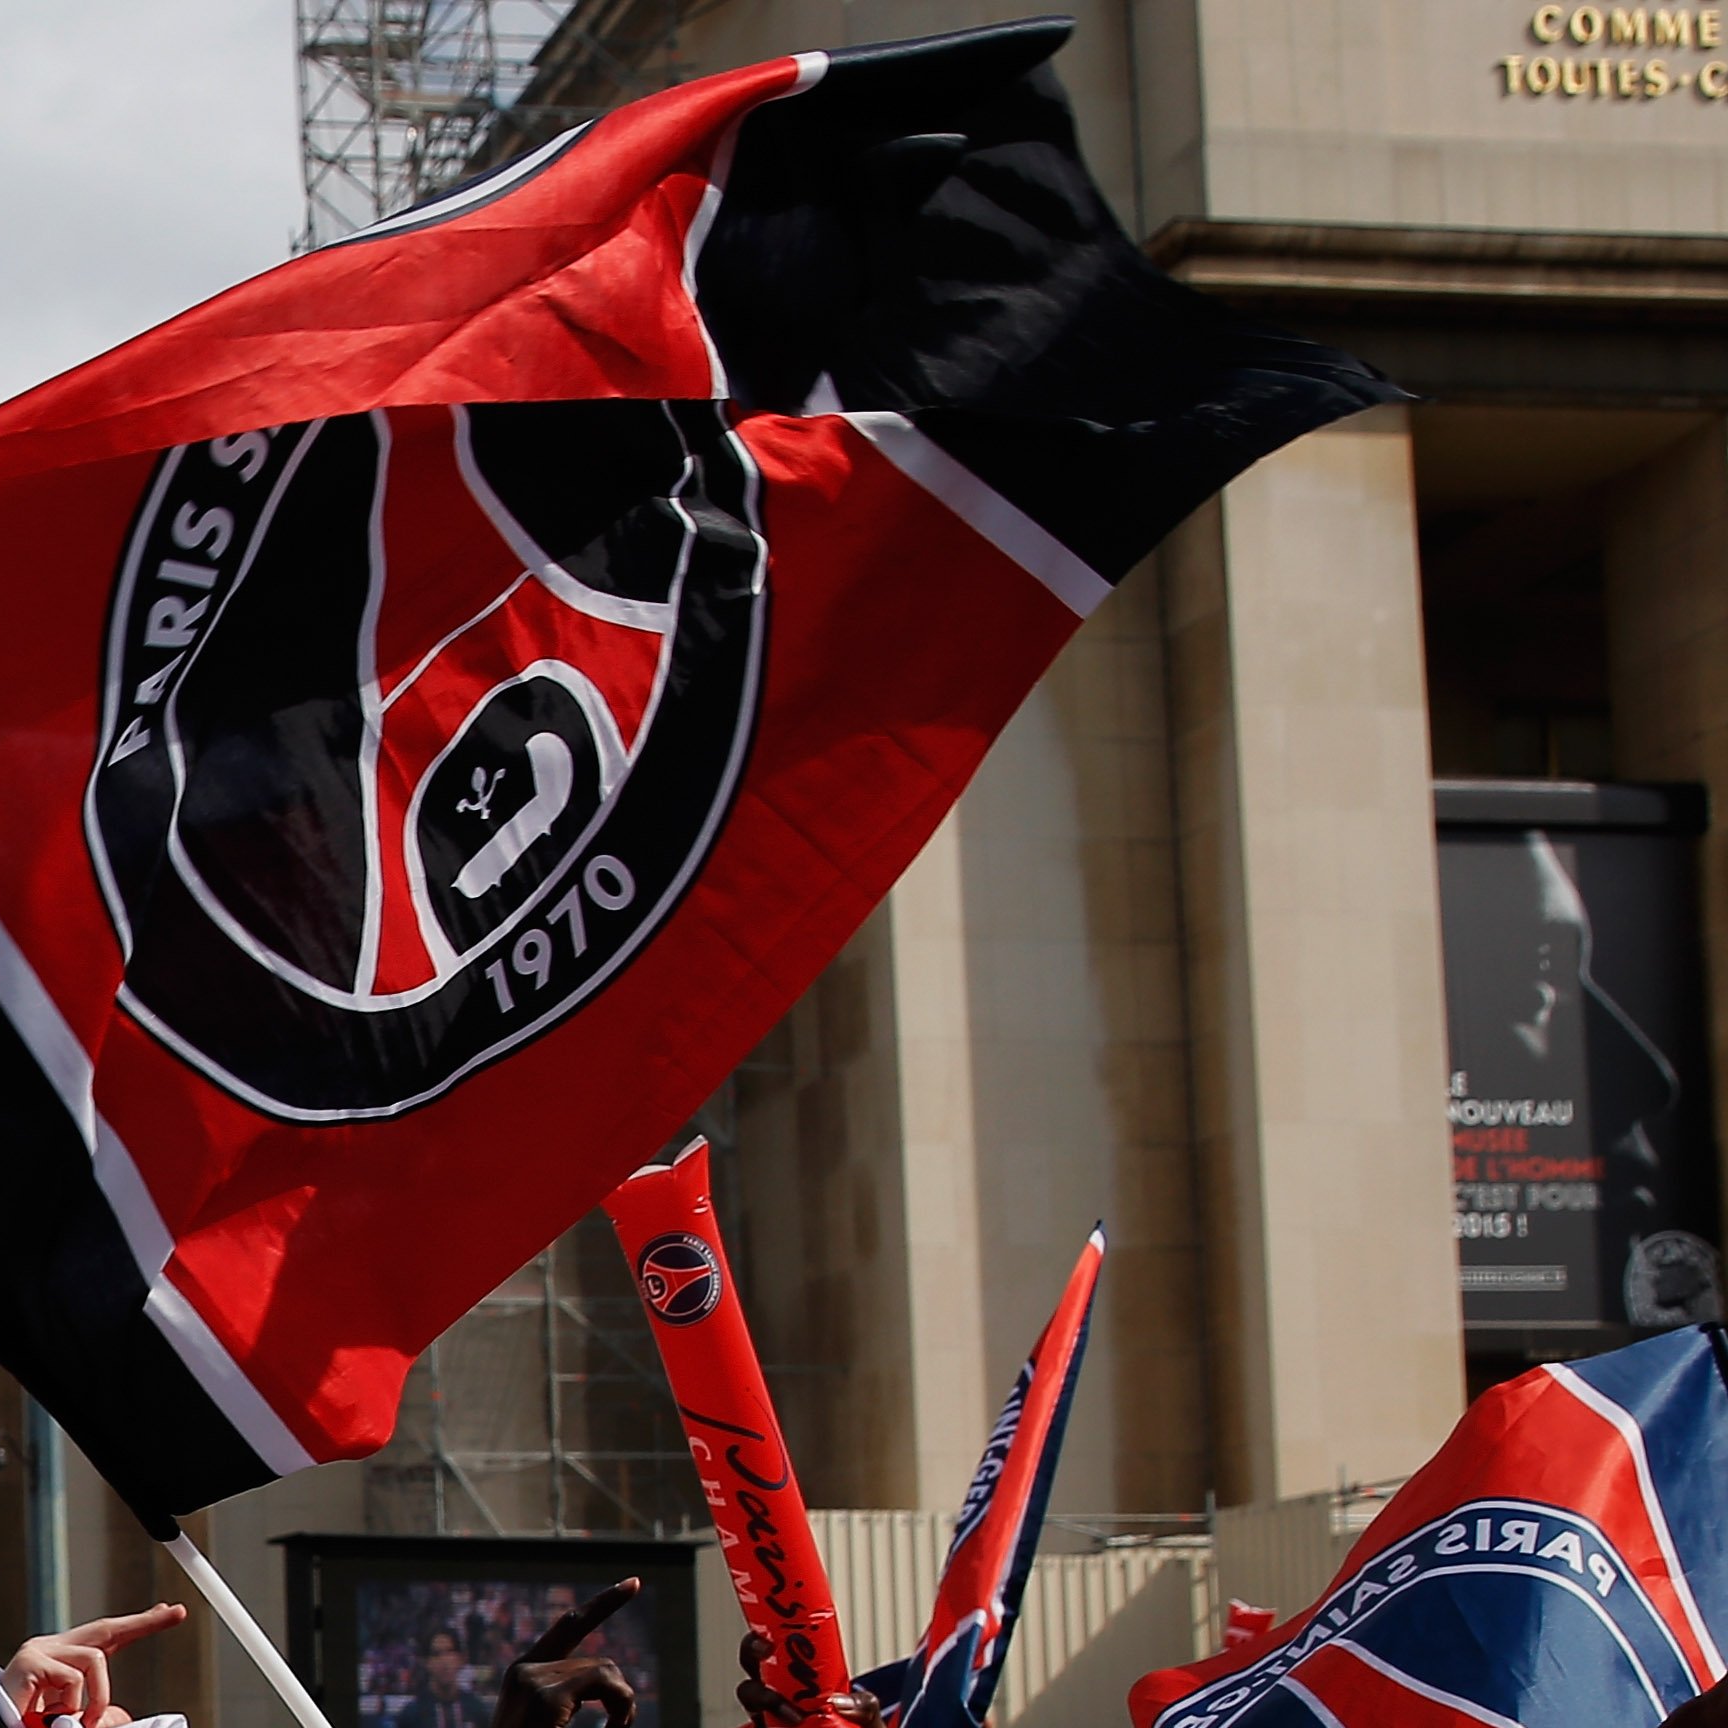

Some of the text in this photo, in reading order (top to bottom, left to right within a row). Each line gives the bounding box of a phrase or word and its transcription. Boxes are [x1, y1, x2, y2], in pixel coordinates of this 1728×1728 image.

[1502, 54, 1670, 97] TOUTES
[1532, 4, 1722, 48] COMME
[108, 500, 234, 768] PARIS
[484, 854, 637, 1014] 1970
